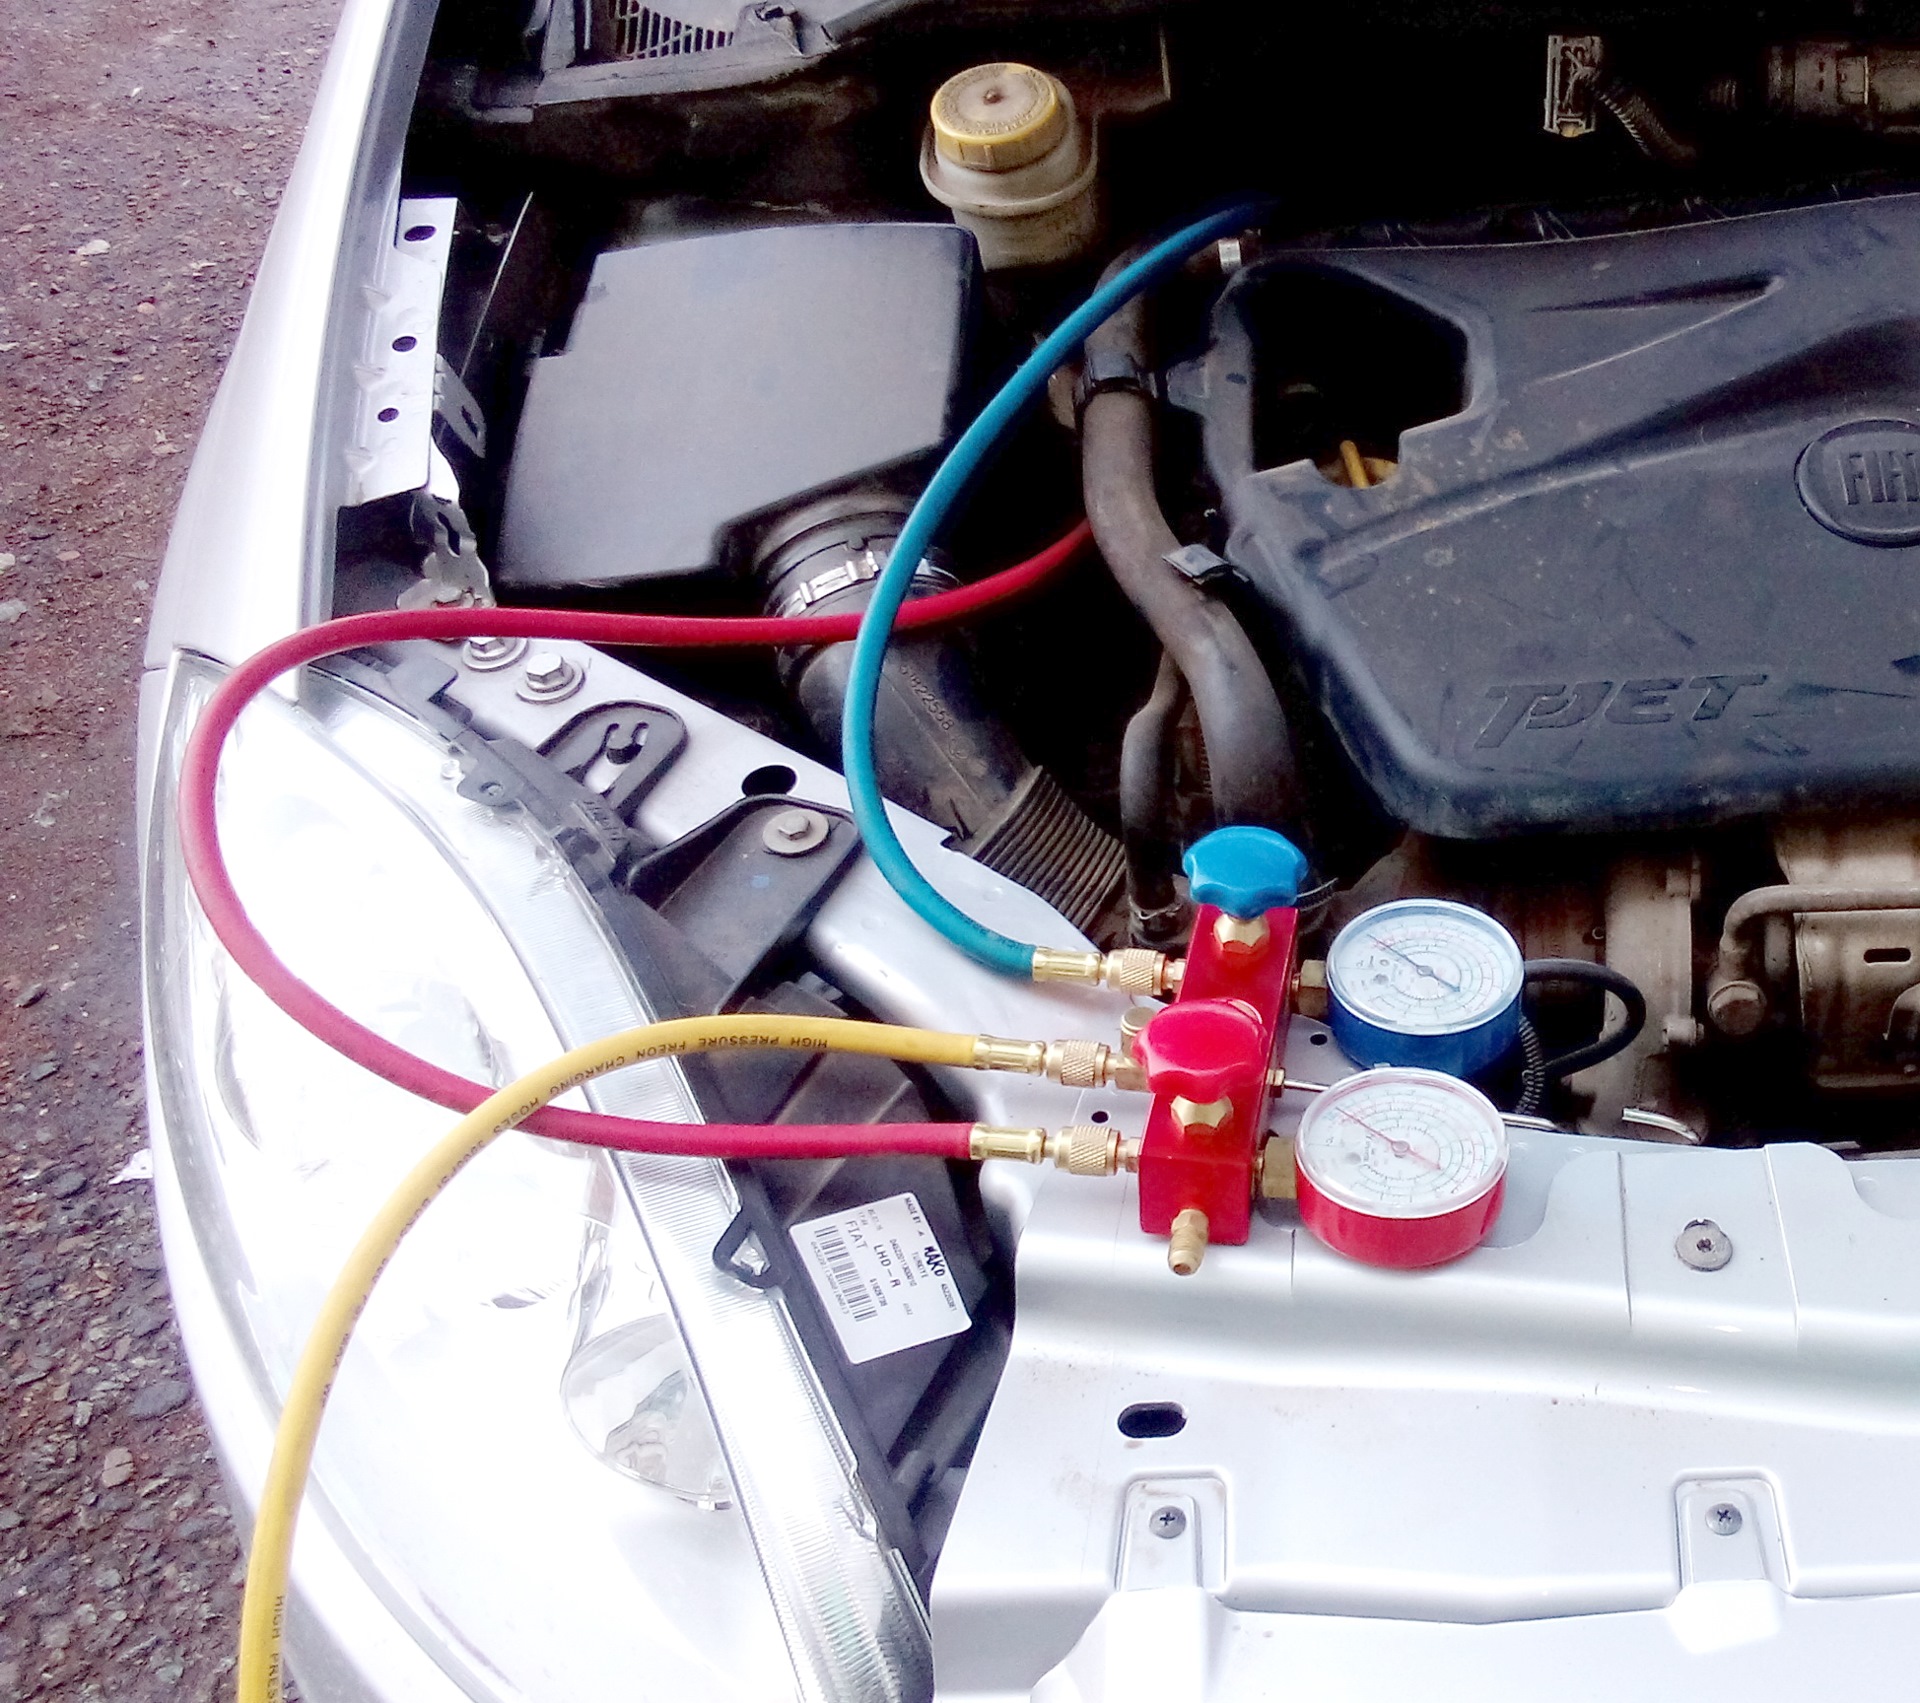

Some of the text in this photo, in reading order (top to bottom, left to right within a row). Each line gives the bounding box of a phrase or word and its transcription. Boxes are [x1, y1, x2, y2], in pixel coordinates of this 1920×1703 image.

[636, 1040, 687, 1059] FREON
[698, 1035, 780, 1048] PRESSURE
[790, 1036, 828, 1049] HIGH
[549, 1056, 625, 1096] CHARGING
[493, 1097, 539, 1134] HOSES
[845, 1219, 867, 1249] FIAT
[923, 1245, 946, 1277] MAKO
[272, 1595, 284, 1639] HIGH
